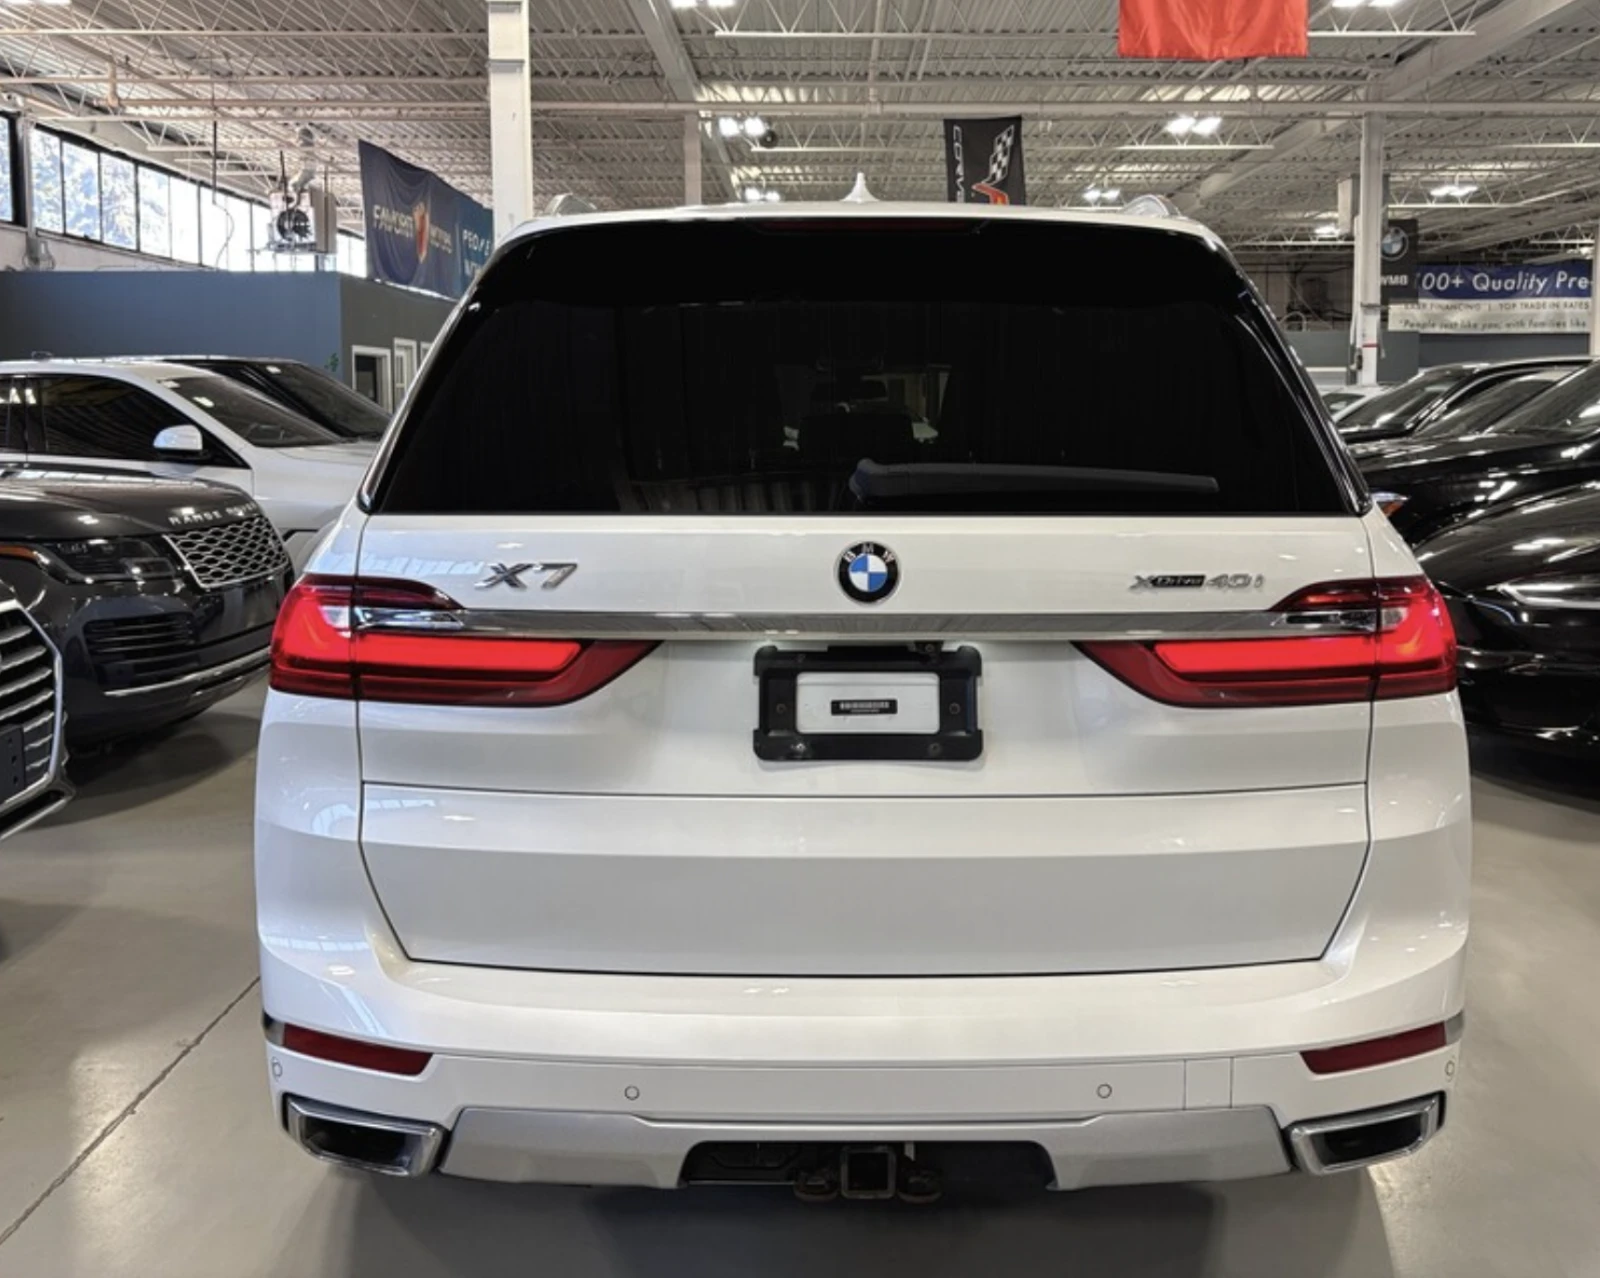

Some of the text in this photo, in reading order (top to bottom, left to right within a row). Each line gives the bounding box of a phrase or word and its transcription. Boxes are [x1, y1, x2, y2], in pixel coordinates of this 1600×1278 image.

[1472, 271, 1548, 295] Quality
[1499, 302, 1517, 311] TOP
[1563, 301, 1589, 310] RATES
[474, 562, 577, 590] X7
